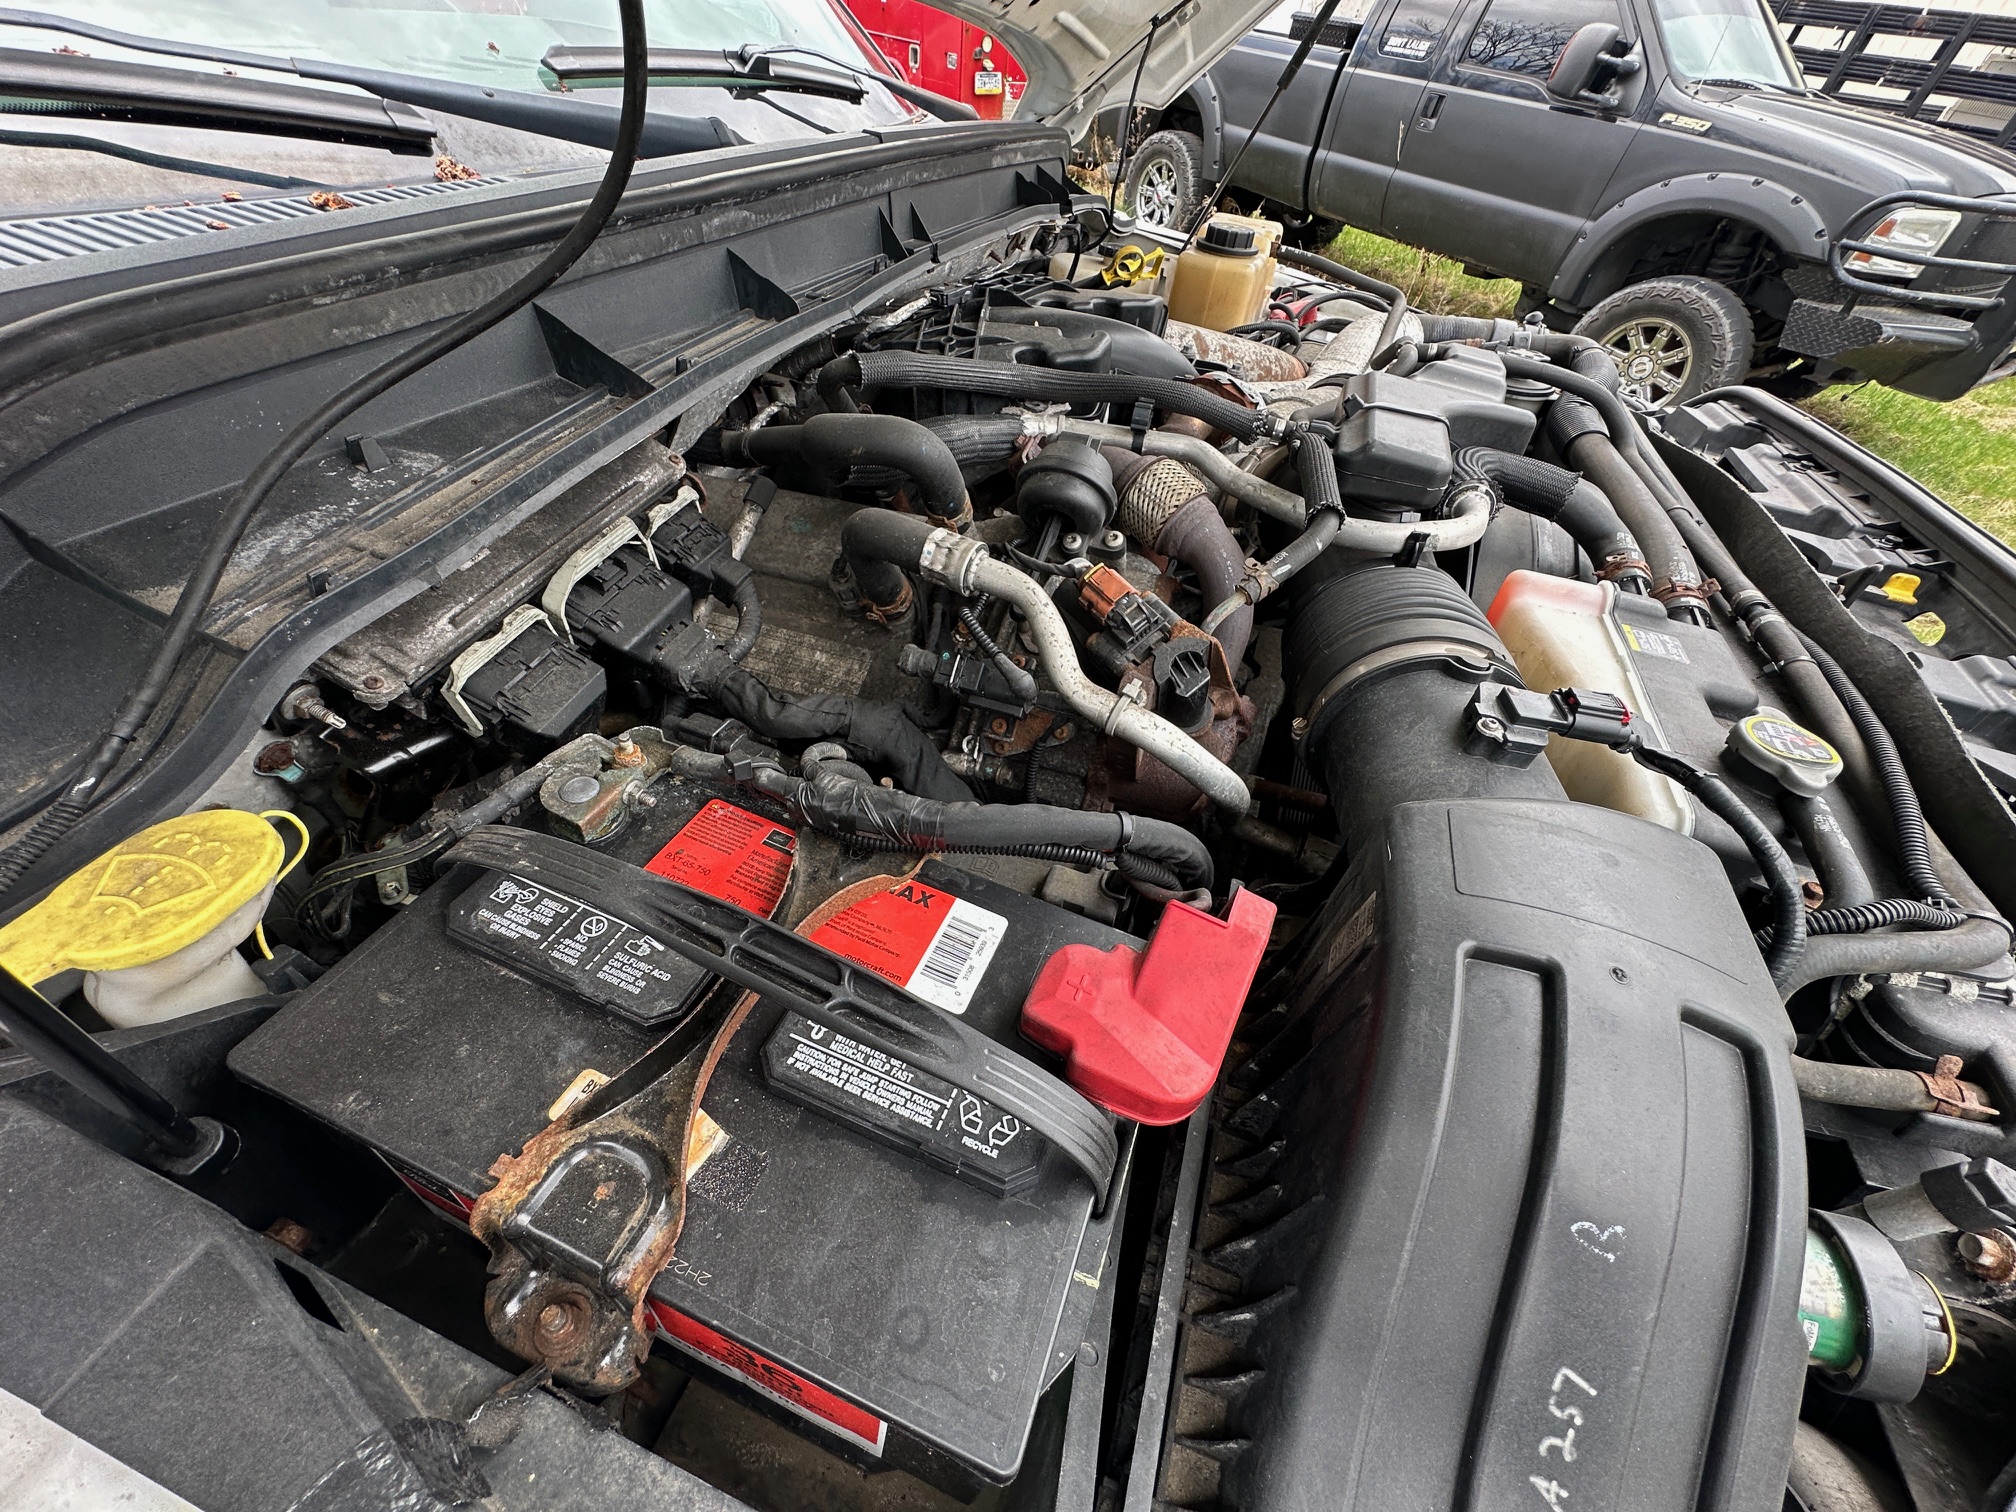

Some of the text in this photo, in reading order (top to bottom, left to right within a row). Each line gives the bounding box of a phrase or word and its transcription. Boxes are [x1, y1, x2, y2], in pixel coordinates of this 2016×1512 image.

[664, 852, 712, 877] BXT-65-750
[540, 897, 569, 914] SHIELD
[724, 894, 742, 907] 750
[889, 885, 936, 909] AX
[478, 908, 491, 919] CAN
[490, 913, 511, 927] CAUSE
[504, 910, 532, 926] GASES
[510, 903, 554, 926] EXPLOSIVE
[534, 904, 556, 918] EYES
[499, 926, 522, 940] INJURY
[574, 933, 589, 943] NO
[602, 964, 636, 983] BLINDNESS
[608, 958, 644, 978] CAN CAUSE
[613, 950, 672, 982] SULFURIC ACID
[844, 952, 903, 982] motorcraft.com
[596, 970, 642, 995] SEVERE BURNS
[792, 1051, 840, 1078] INSTRUCTIONS
[848, 1074, 877, 1094] VEHICLE
[829, 1040, 915, 1083] MEDICAL HELP FAST
[786, 1056, 796, 1066] IF
[794, 1060, 811, 1074] NOT
[809, 1068, 845, 1088] AVAILABLE
[844, 1082, 863, 1097] SEEK
[862, 1091, 892, 1109] SERVICE
[841, 1062, 861, 1077] SAFE
[858, 1069, 880, 1087] JUMP
[878, 1077, 912, 1098] STARTING
[911, 1091, 941, 1112] FOLLOW
[961, 1135, 1000, 1159] RECYCLE
[718, 1335, 803, 1393] 36
[1538, 1366, 1598, 1463] 257
